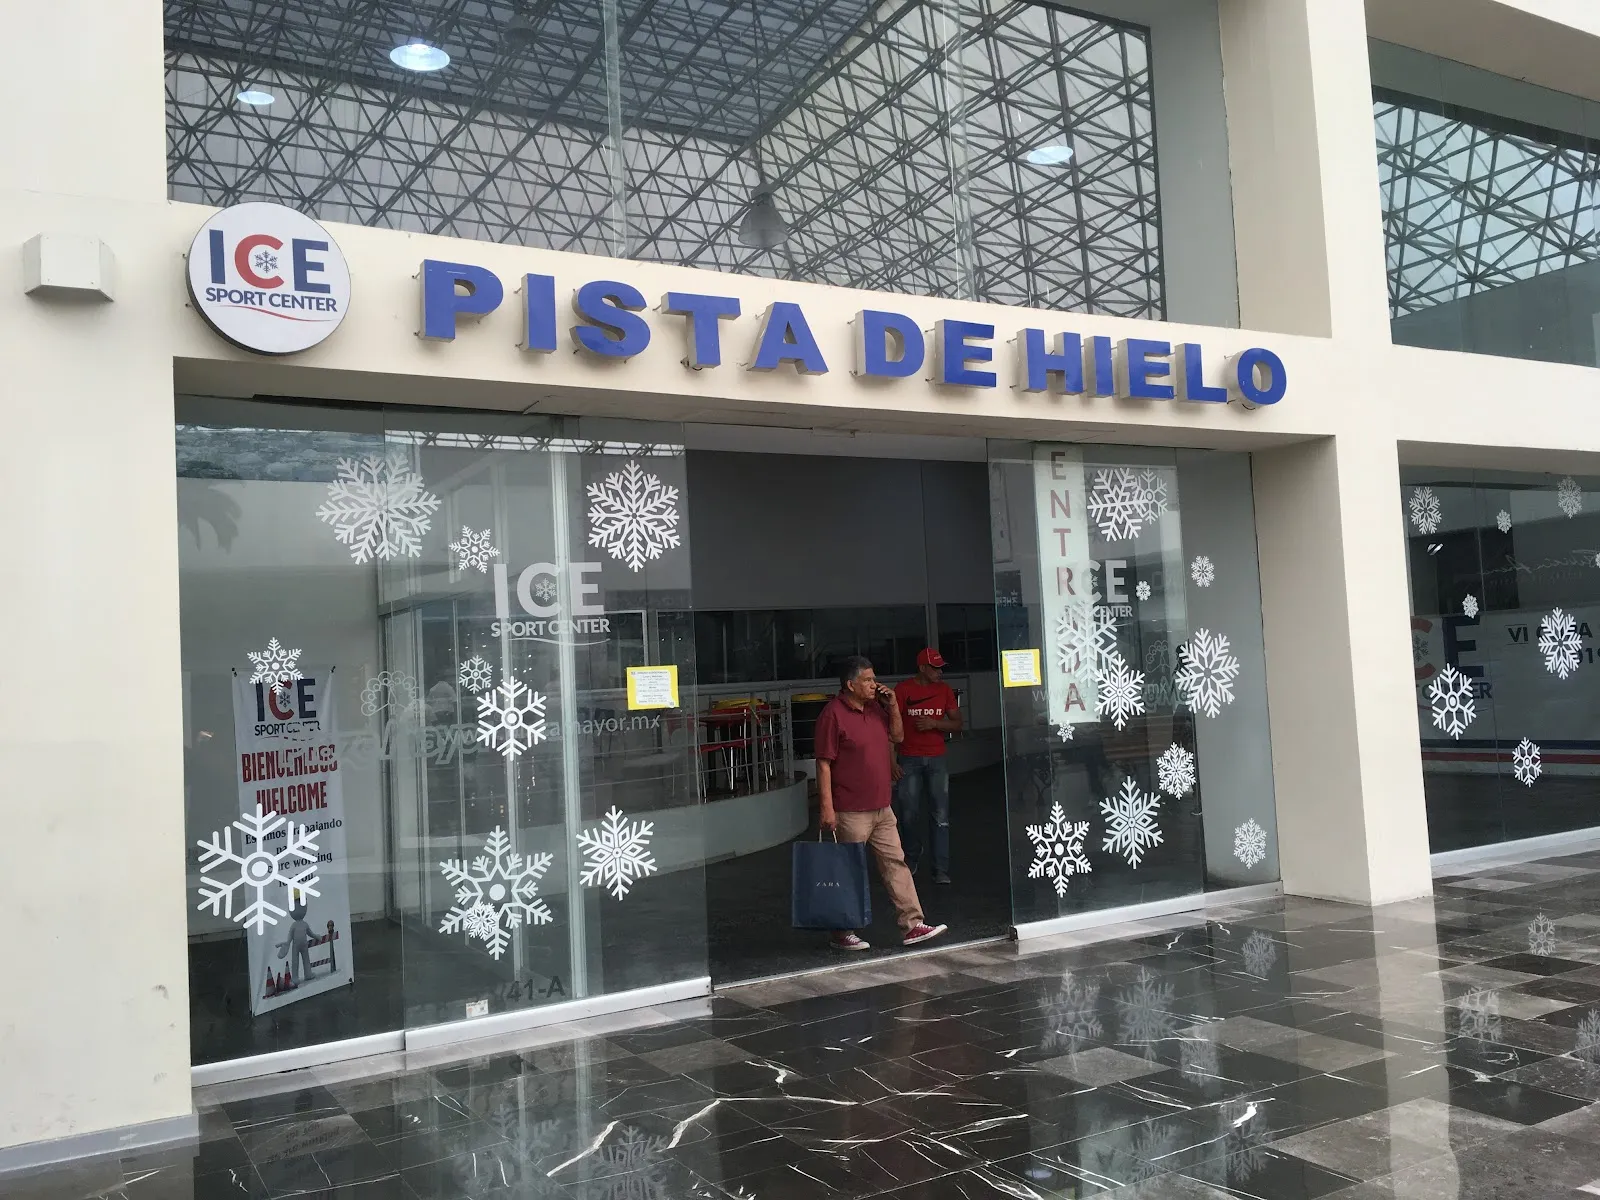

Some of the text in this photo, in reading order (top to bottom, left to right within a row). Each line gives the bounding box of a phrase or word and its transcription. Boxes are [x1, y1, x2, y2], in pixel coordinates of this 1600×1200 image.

[208, 229, 331, 294] ICE
[205, 286, 338, 313] SPORT CENTER
[420, 259, 1288, 406] PISTA DE HIELO
[493, 561, 605, 619] ICE
[1050, 451, 1087, 713] ENTRDA
[1068, 559, 1129, 603] CE
[491, 618, 611, 637] SPORT CENTER
[1411, 615, 1485, 681] CE
[255, 677, 317, 722] ICE
[1422, 682, 1492, 699] CER
[254, 722, 285, 736] SPORT
[256, 780, 328, 817] WELCOME
[245, 818, 343, 845] Esmos rabajando
[293, 852, 333, 866] woing
